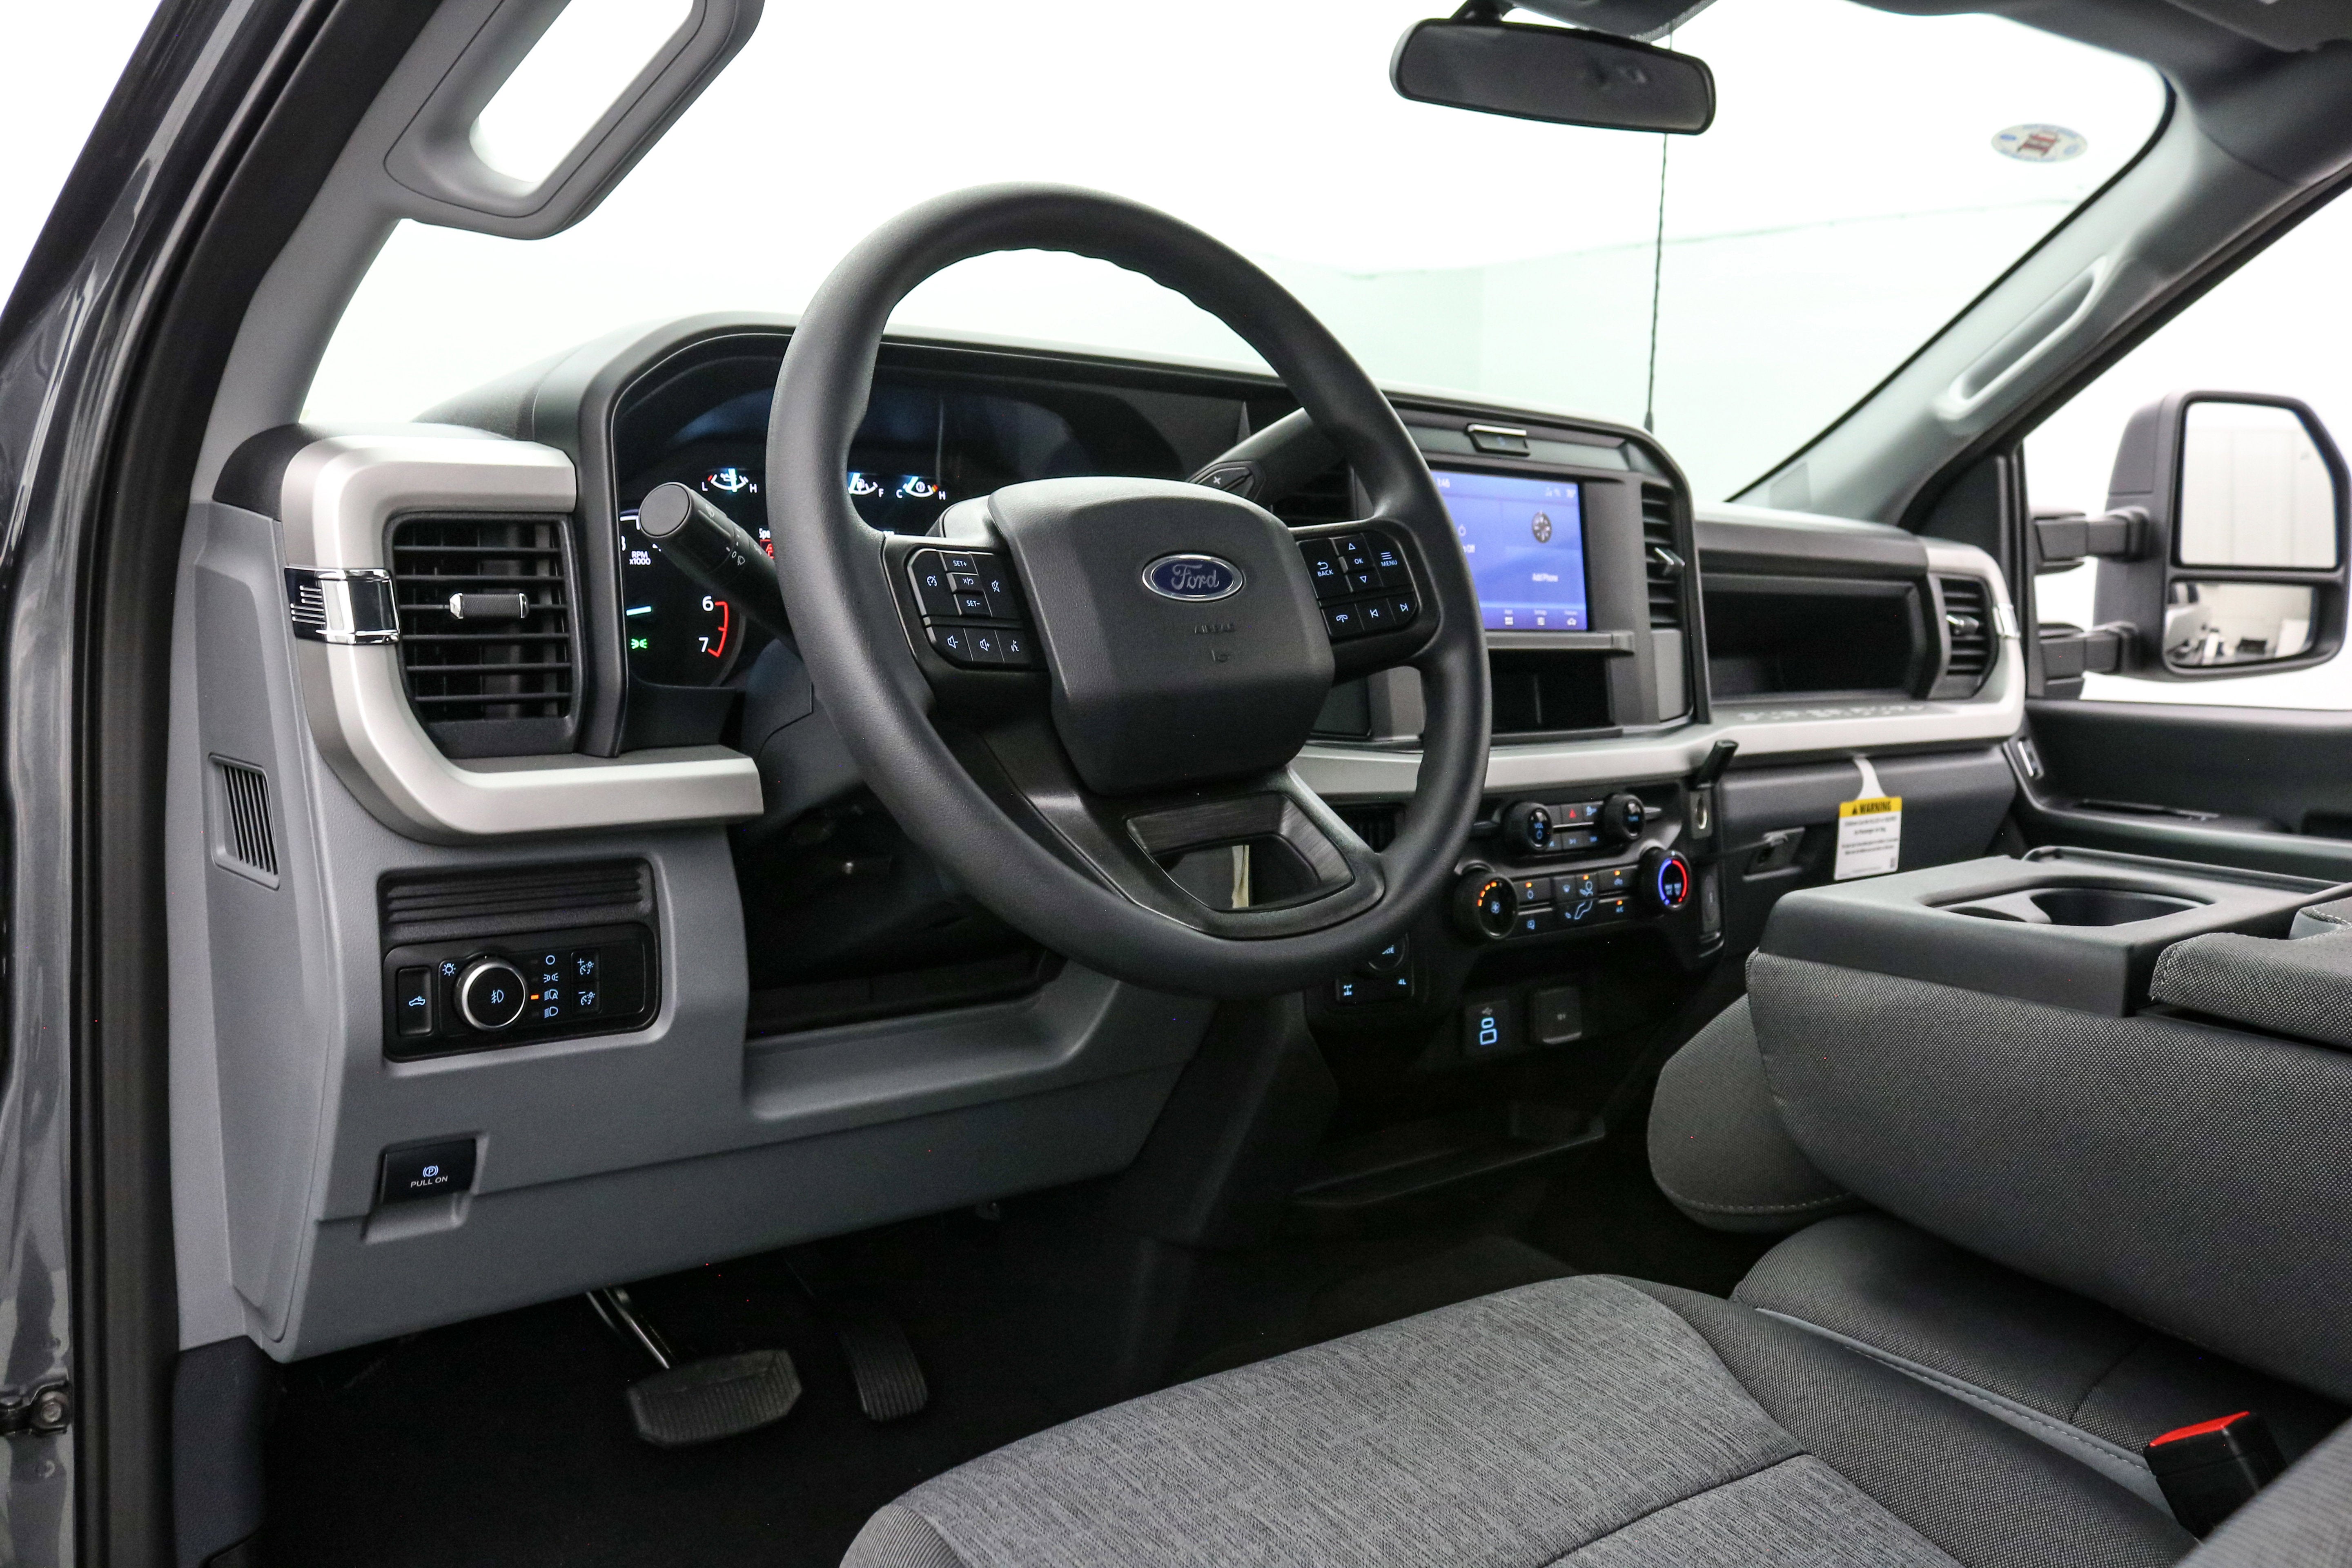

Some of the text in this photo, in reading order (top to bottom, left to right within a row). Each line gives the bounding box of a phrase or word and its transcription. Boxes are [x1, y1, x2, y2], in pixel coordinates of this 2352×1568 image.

[702, 481, 708, 491] L
[749, 483, 757, 493] H
[878, 488, 884, 497] F
[896, 489, 903, 499] C
[938, 491, 946, 500] H
[759, 528, 771, 540] Spe
[1171, 564, 1219, 590] Ford
[702, 595, 714, 612] 6
[698, 636, 709, 653] 7
[1860, 801, 1891, 814] WARNING
[410, 1176, 448, 1188] PULL ON
